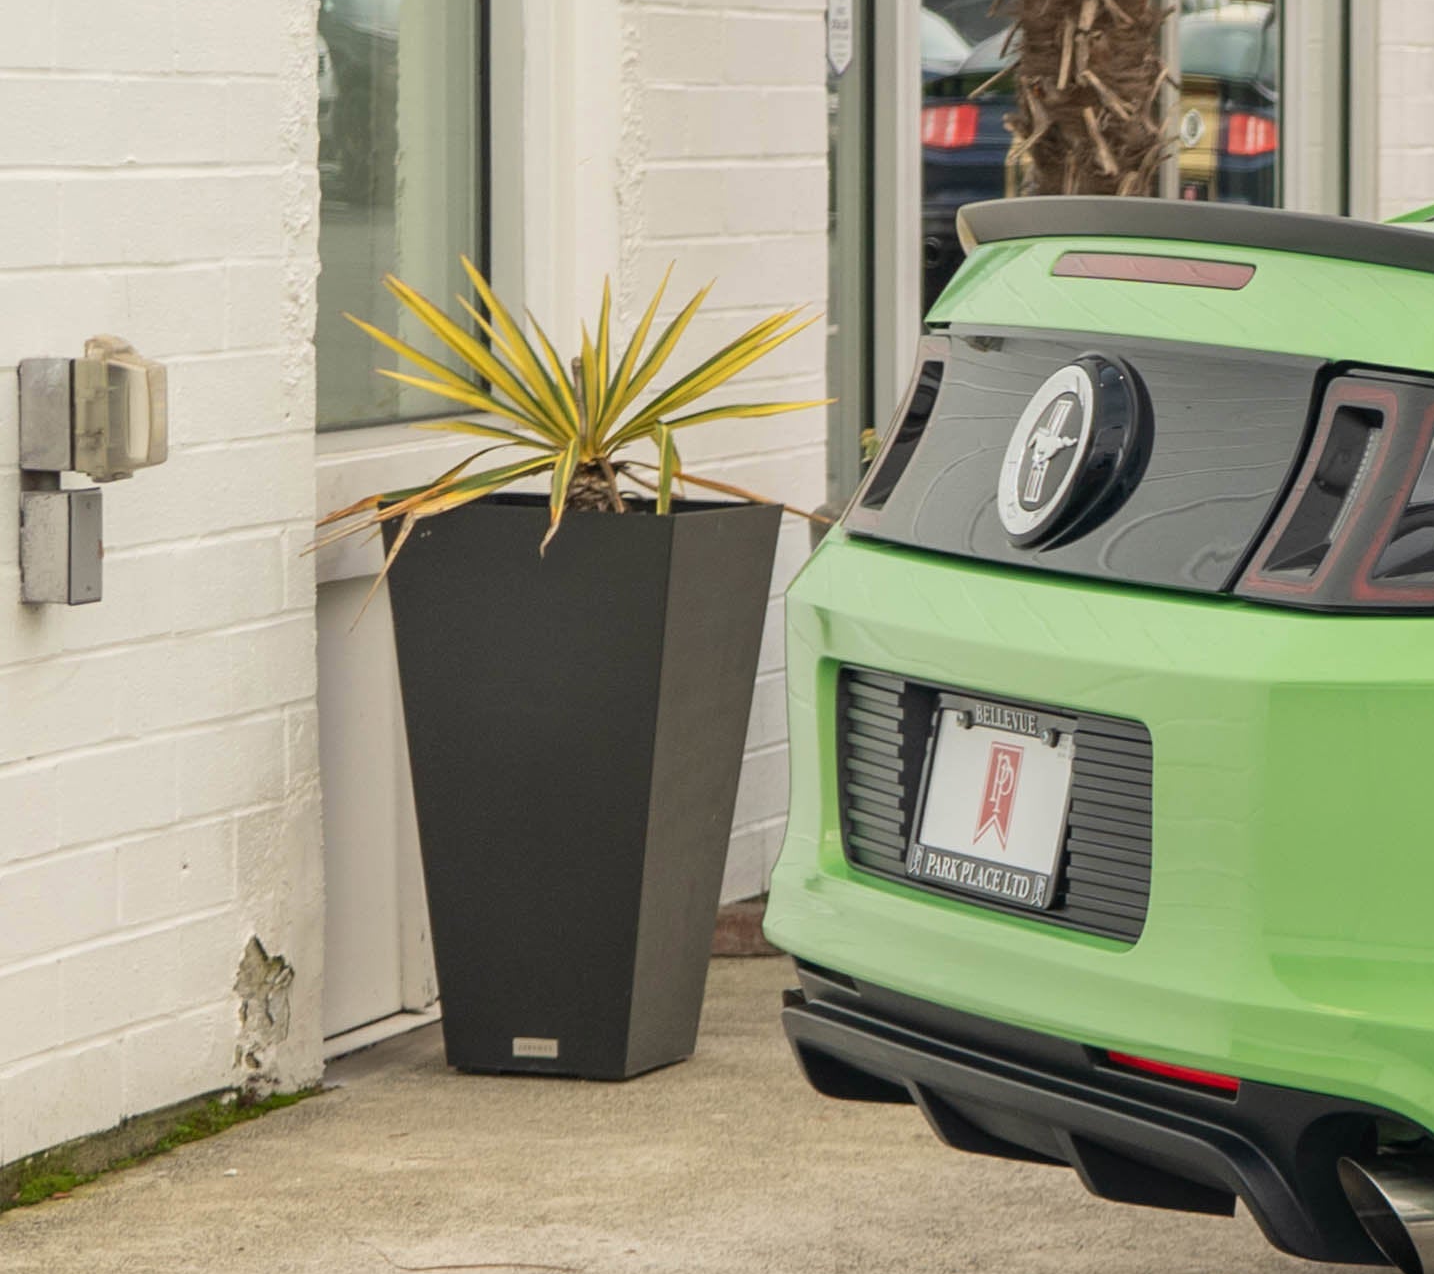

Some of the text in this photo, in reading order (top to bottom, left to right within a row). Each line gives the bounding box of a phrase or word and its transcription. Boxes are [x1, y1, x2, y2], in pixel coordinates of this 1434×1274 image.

[975, 704, 1038, 735] BELLEVUE
[925, 852, 960, 882] PARK
[959, 861, 1003, 893] PLACE
[1002, 871, 1031, 899] LTD
